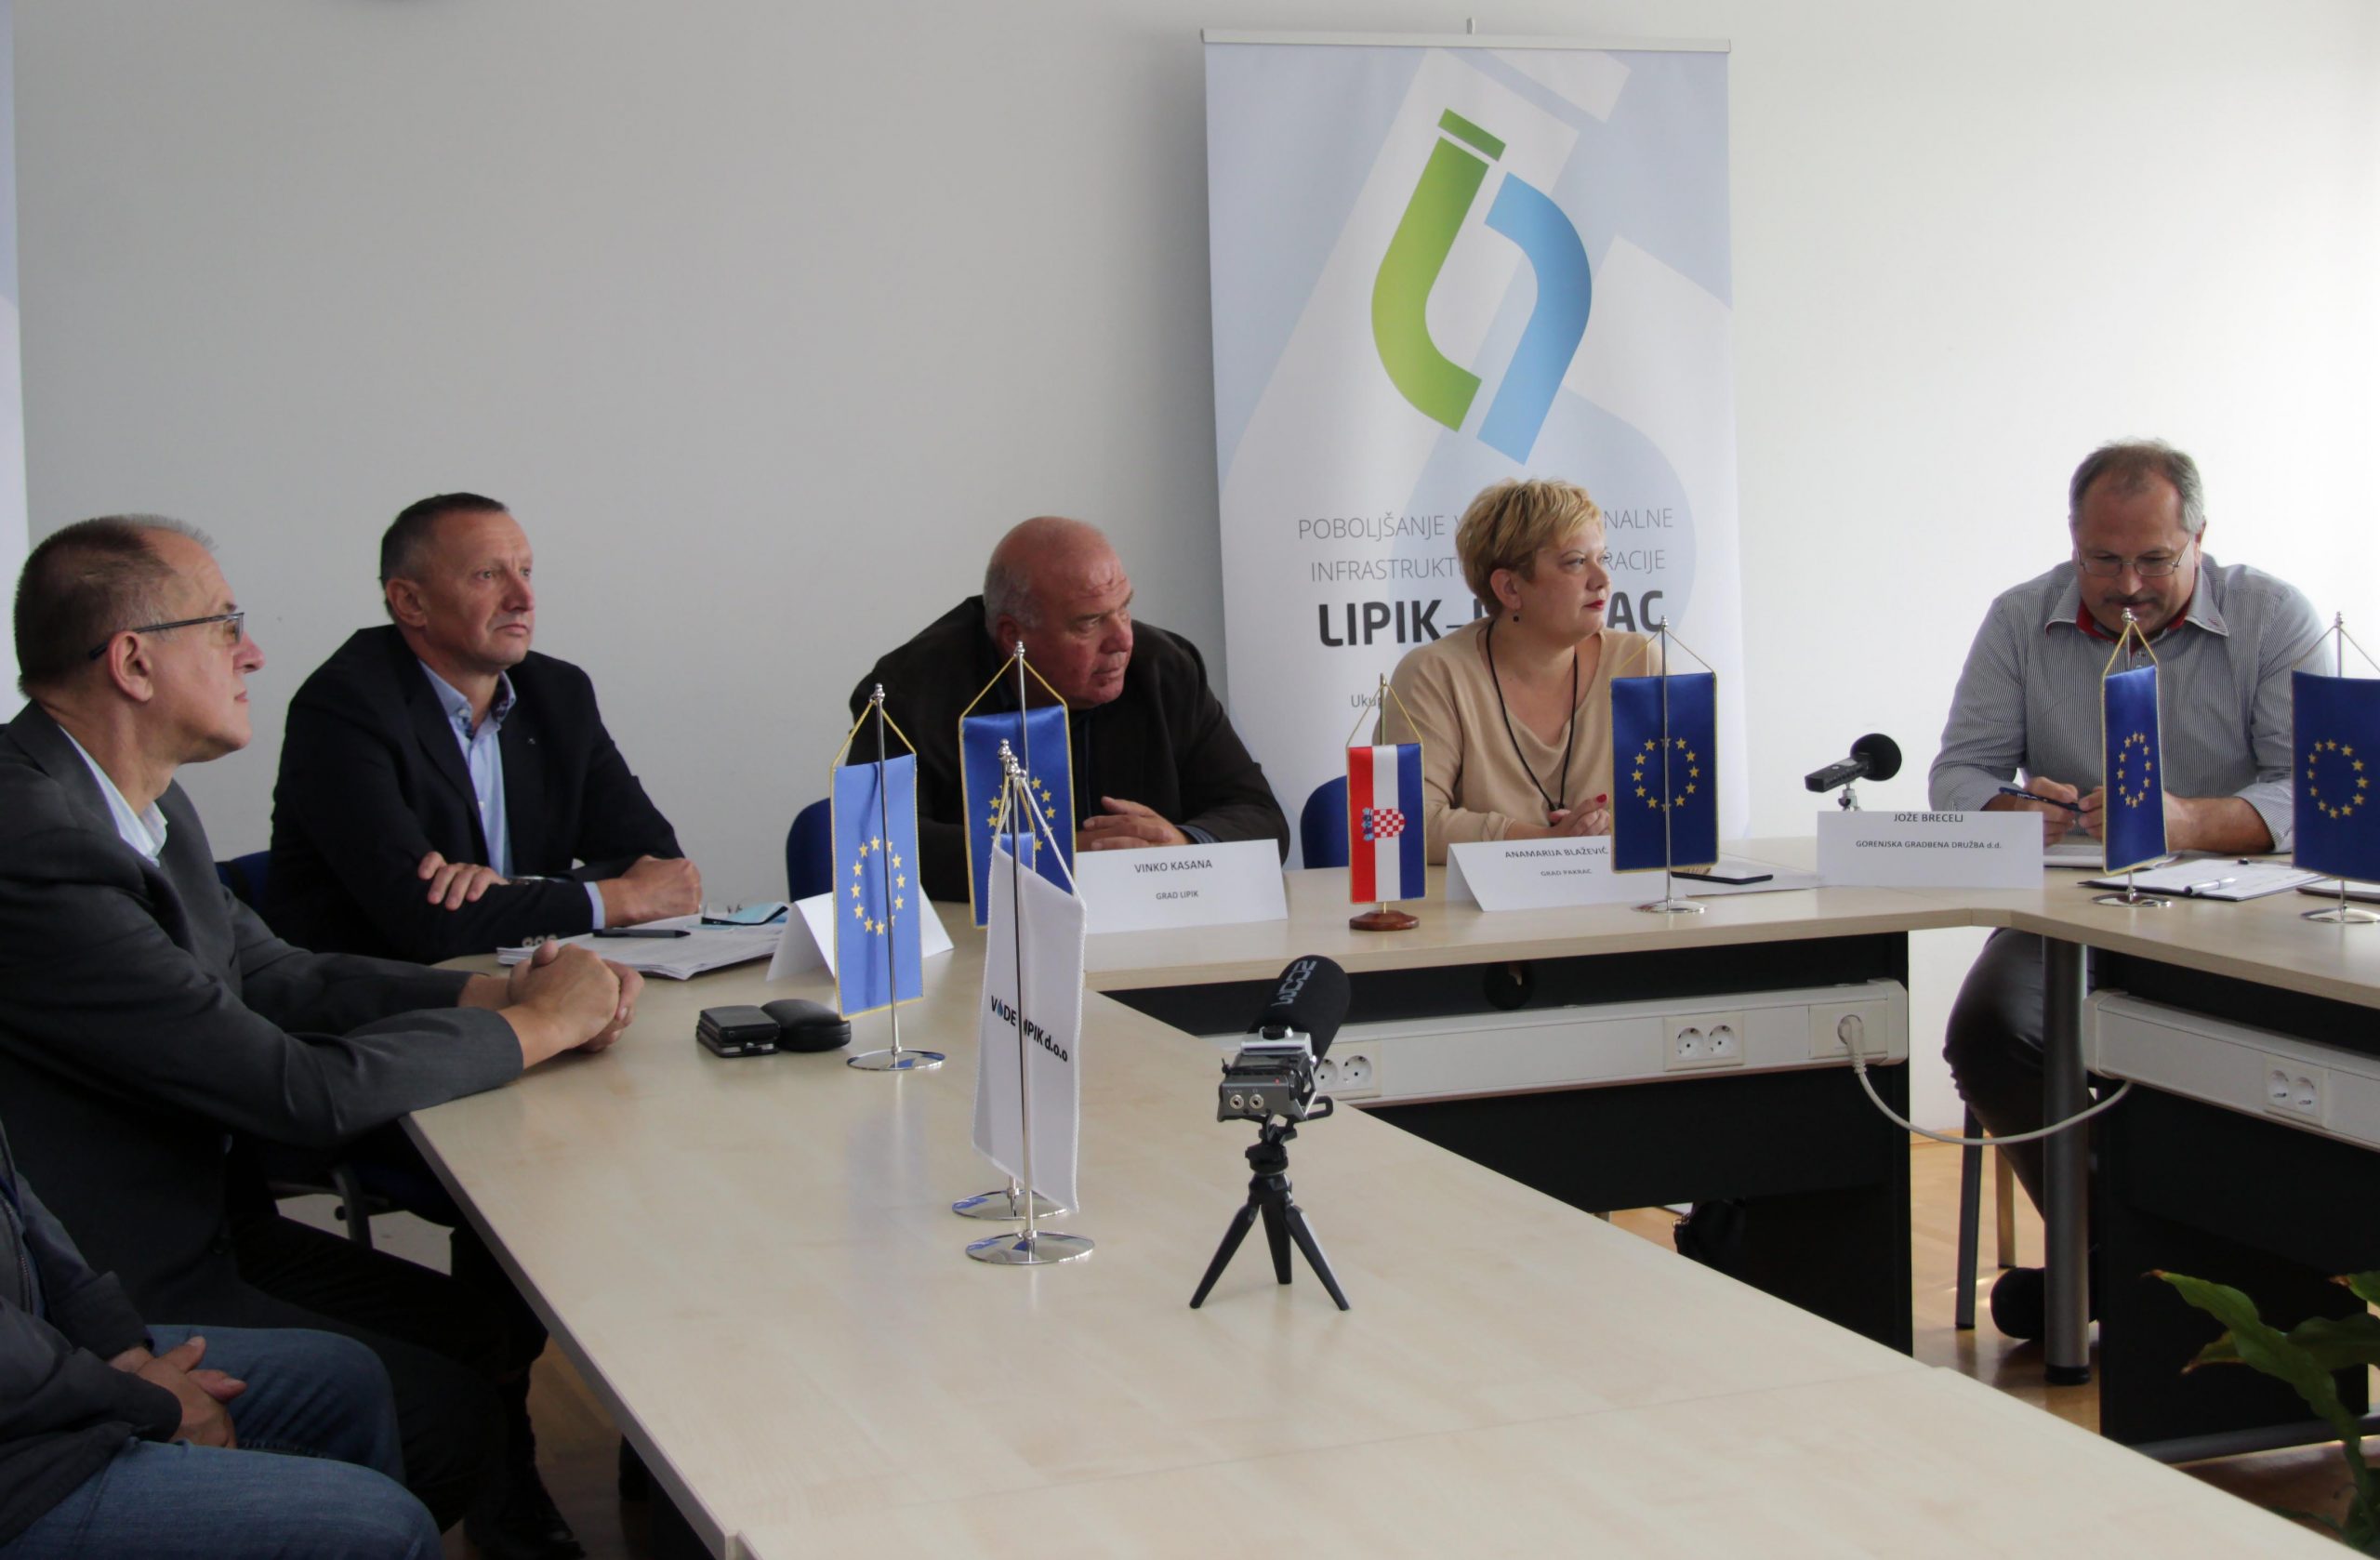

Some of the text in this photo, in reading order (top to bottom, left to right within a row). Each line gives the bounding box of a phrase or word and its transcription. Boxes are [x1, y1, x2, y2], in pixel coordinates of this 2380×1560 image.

[1299, 511, 1446, 542] POBOLJŠANJE
[1311, 557, 1464, 582] INFRASTRUKT
[1894, 813, 1964, 823] JOŽE BRECELJ
[1905, 840, 1950, 849] GRADBENA
[1951, 839, 1985, 849] DRUŽBA
[1505, 849, 1563, 858] ANAMARIJA
[1134, 859, 1213, 873] VINKO KASANA
[1156, 890, 1198, 901] GRAD LIPIK
